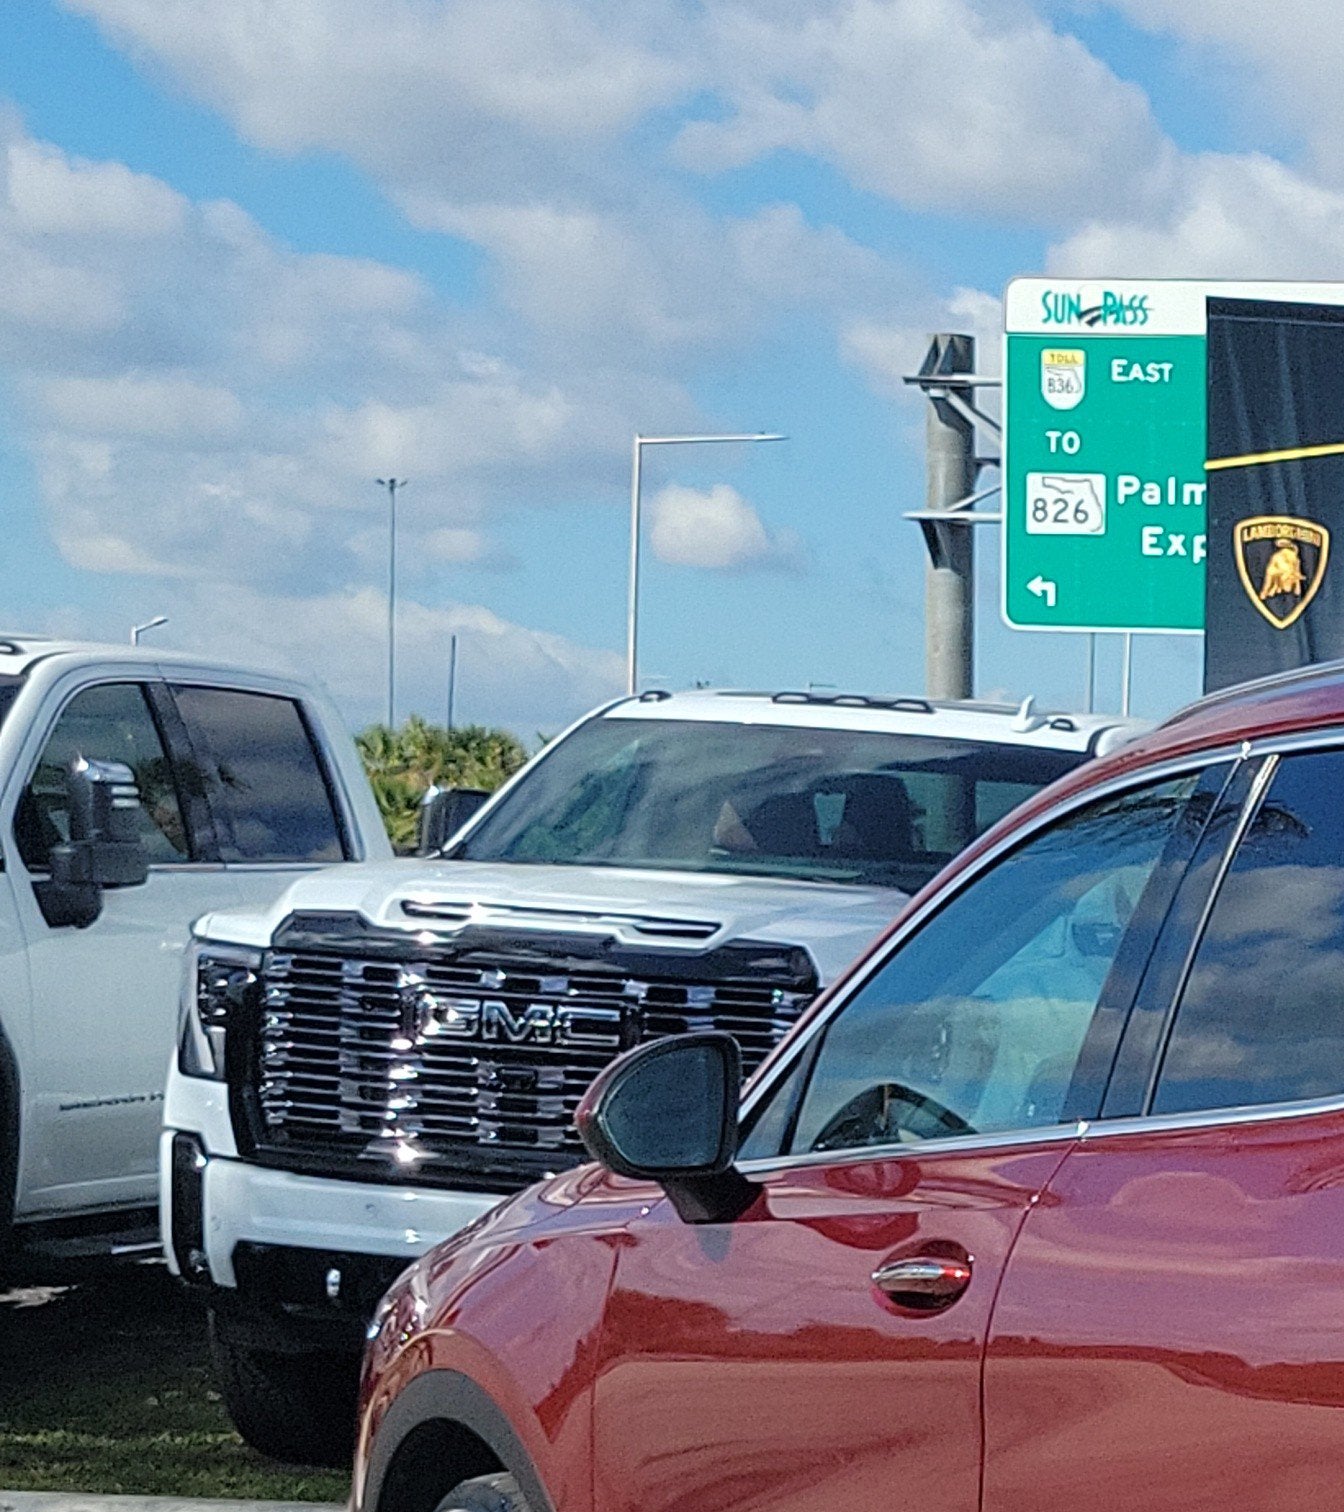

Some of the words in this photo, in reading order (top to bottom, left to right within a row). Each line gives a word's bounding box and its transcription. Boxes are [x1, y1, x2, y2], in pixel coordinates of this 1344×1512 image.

[1049, 353, 1079, 365] TOLL
[1110, 358, 1174, 384] EAST
[1045, 430, 1081, 455] TO
[1032, 497, 1090, 525] 826
[422, 994, 621, 1048] GMC
